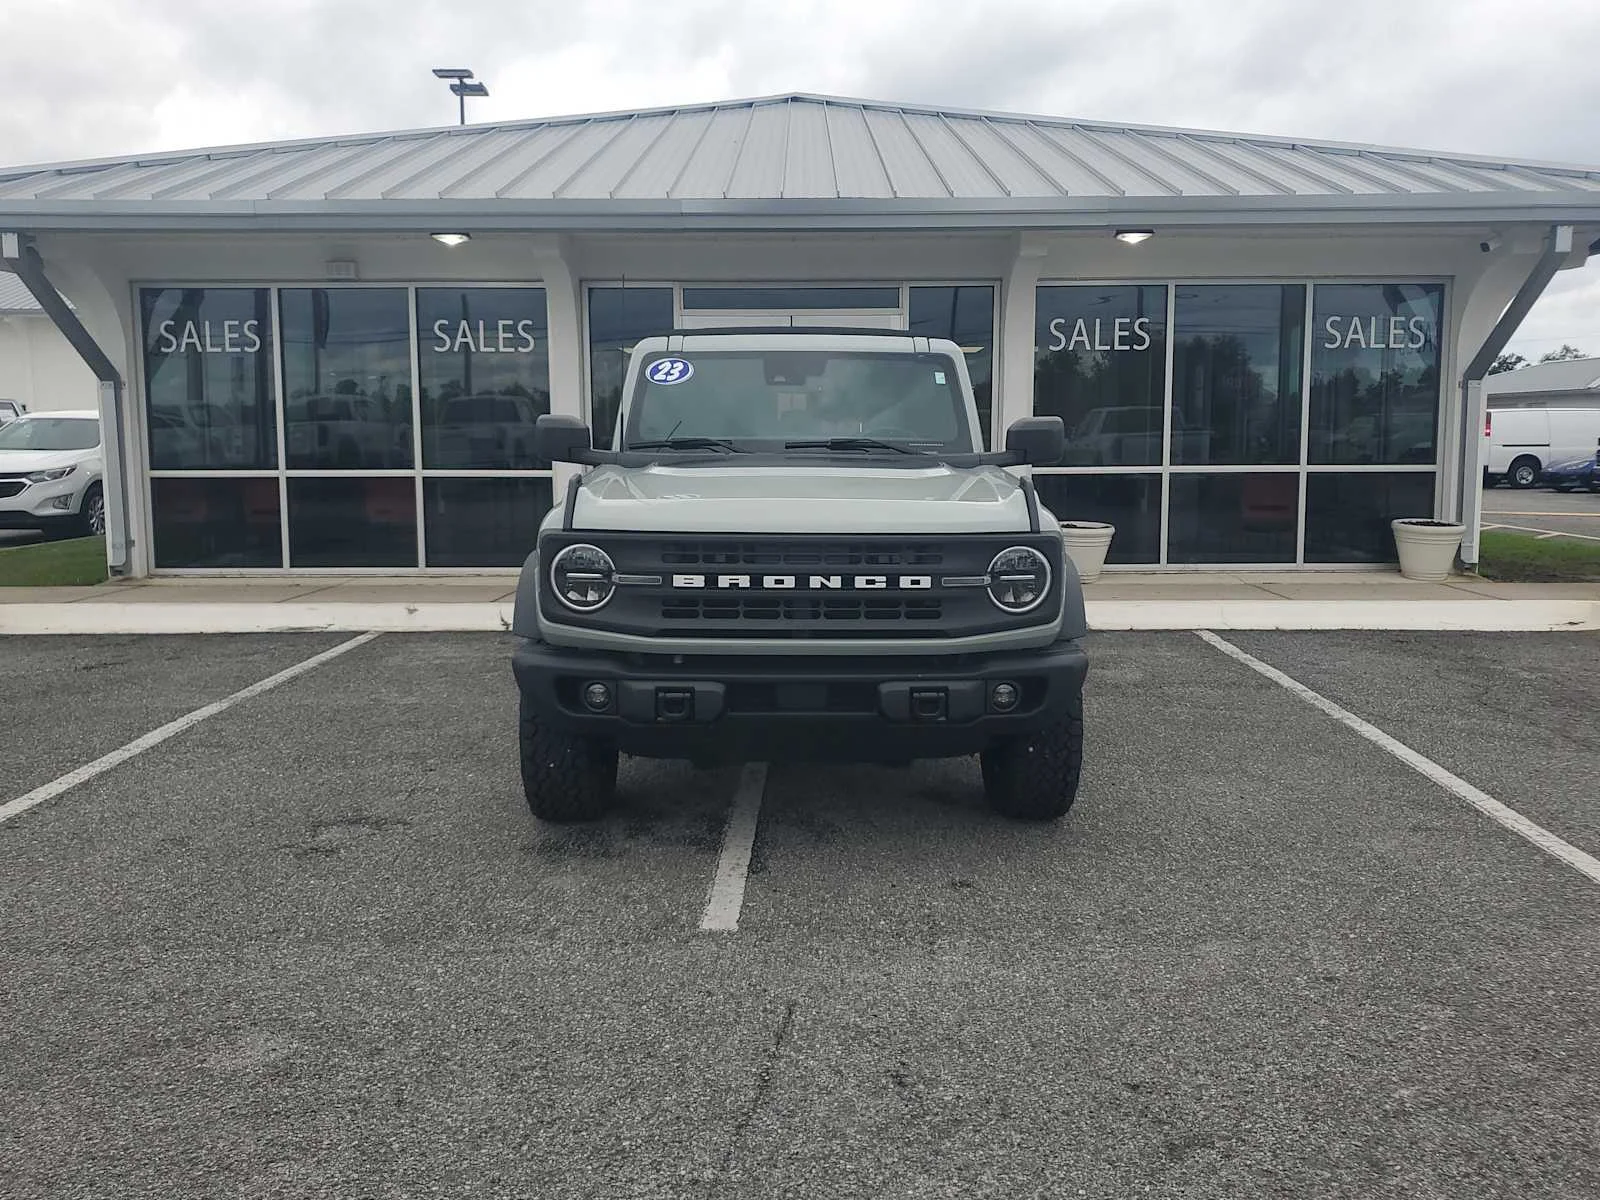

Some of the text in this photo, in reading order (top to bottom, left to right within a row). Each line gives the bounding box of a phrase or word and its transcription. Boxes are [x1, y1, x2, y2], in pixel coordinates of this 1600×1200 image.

[160, 320, 261, 353] SALES
[433, 319, 536, 353] SALES
[1049, 317, 1151, 351] SALES
[1324, 316, 1425, 349] SALES
[653, 361, 685, 381] 23
[672, 574, 932, 589] BRONCO
